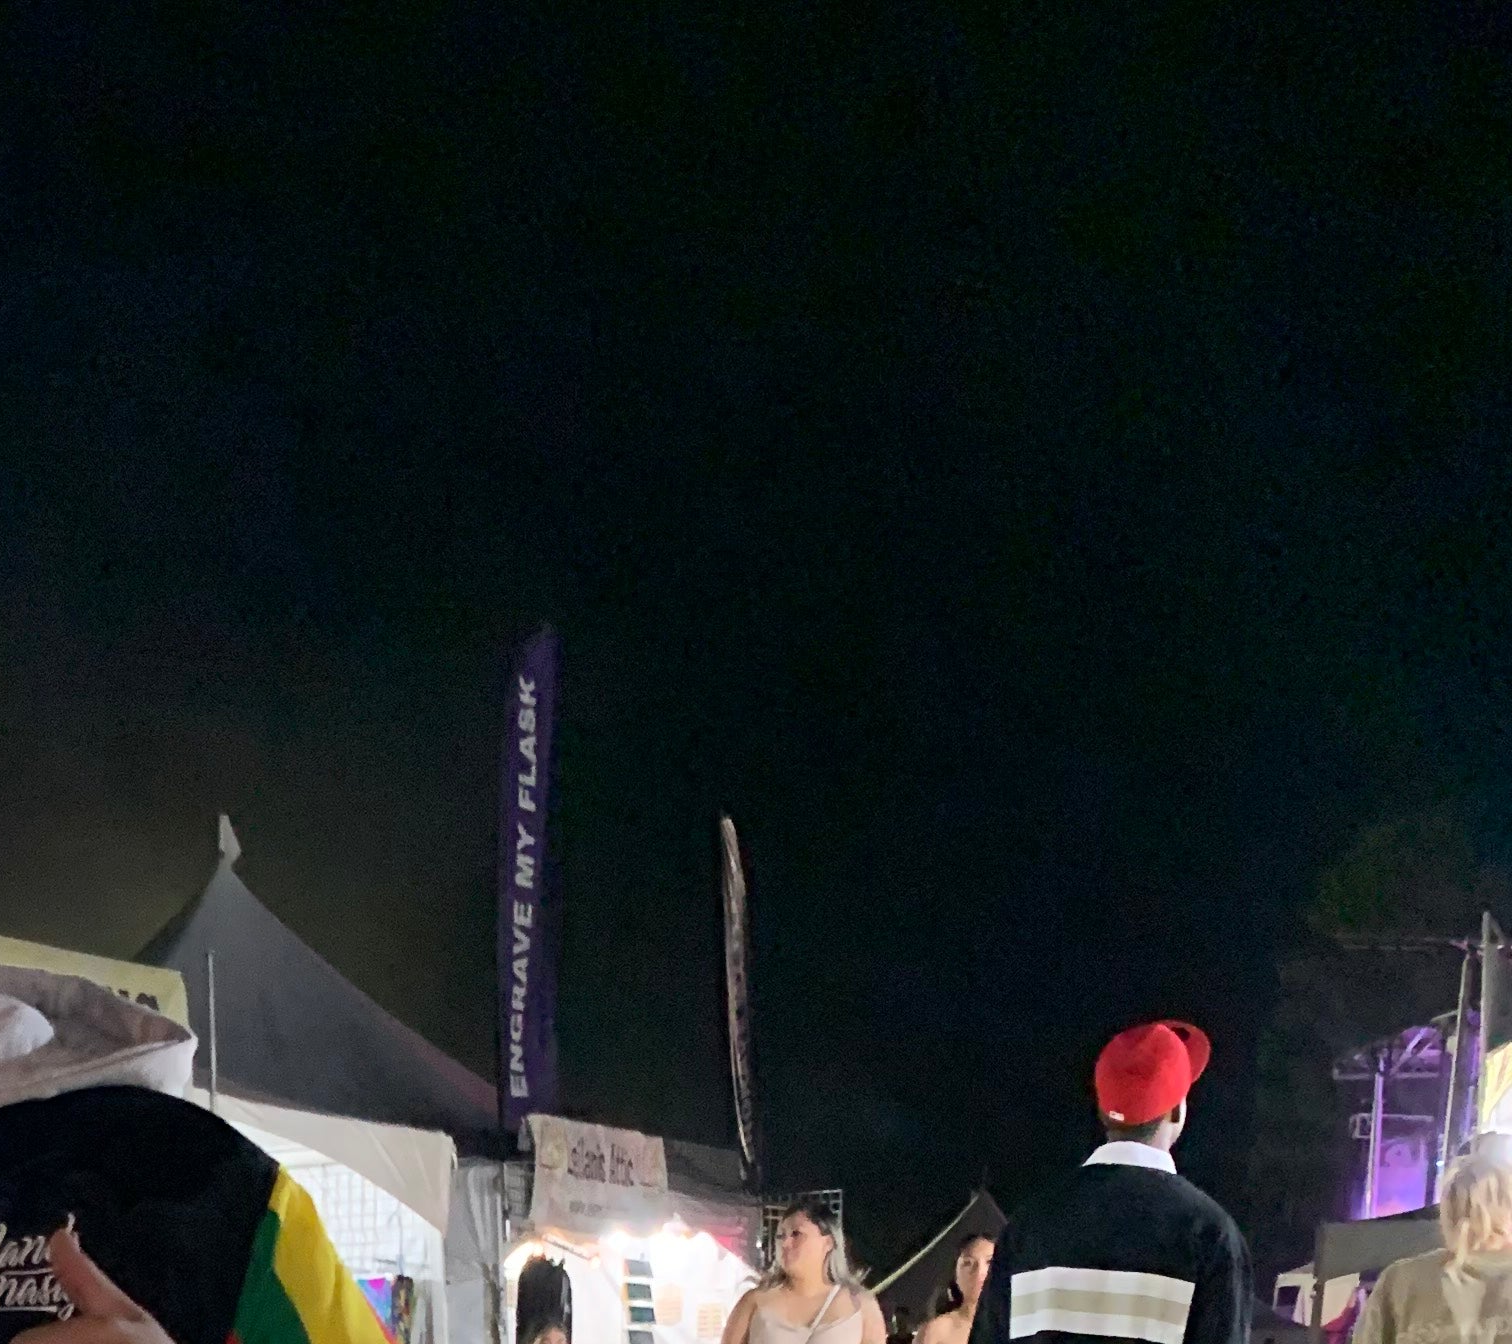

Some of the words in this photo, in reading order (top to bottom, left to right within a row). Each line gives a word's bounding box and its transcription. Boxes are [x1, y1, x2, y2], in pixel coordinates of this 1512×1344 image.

[518, 674, 537, 813] FLASK
[514, 822, 535, 889] MY
[509, 900, 534, 1097] ENGRAVE
